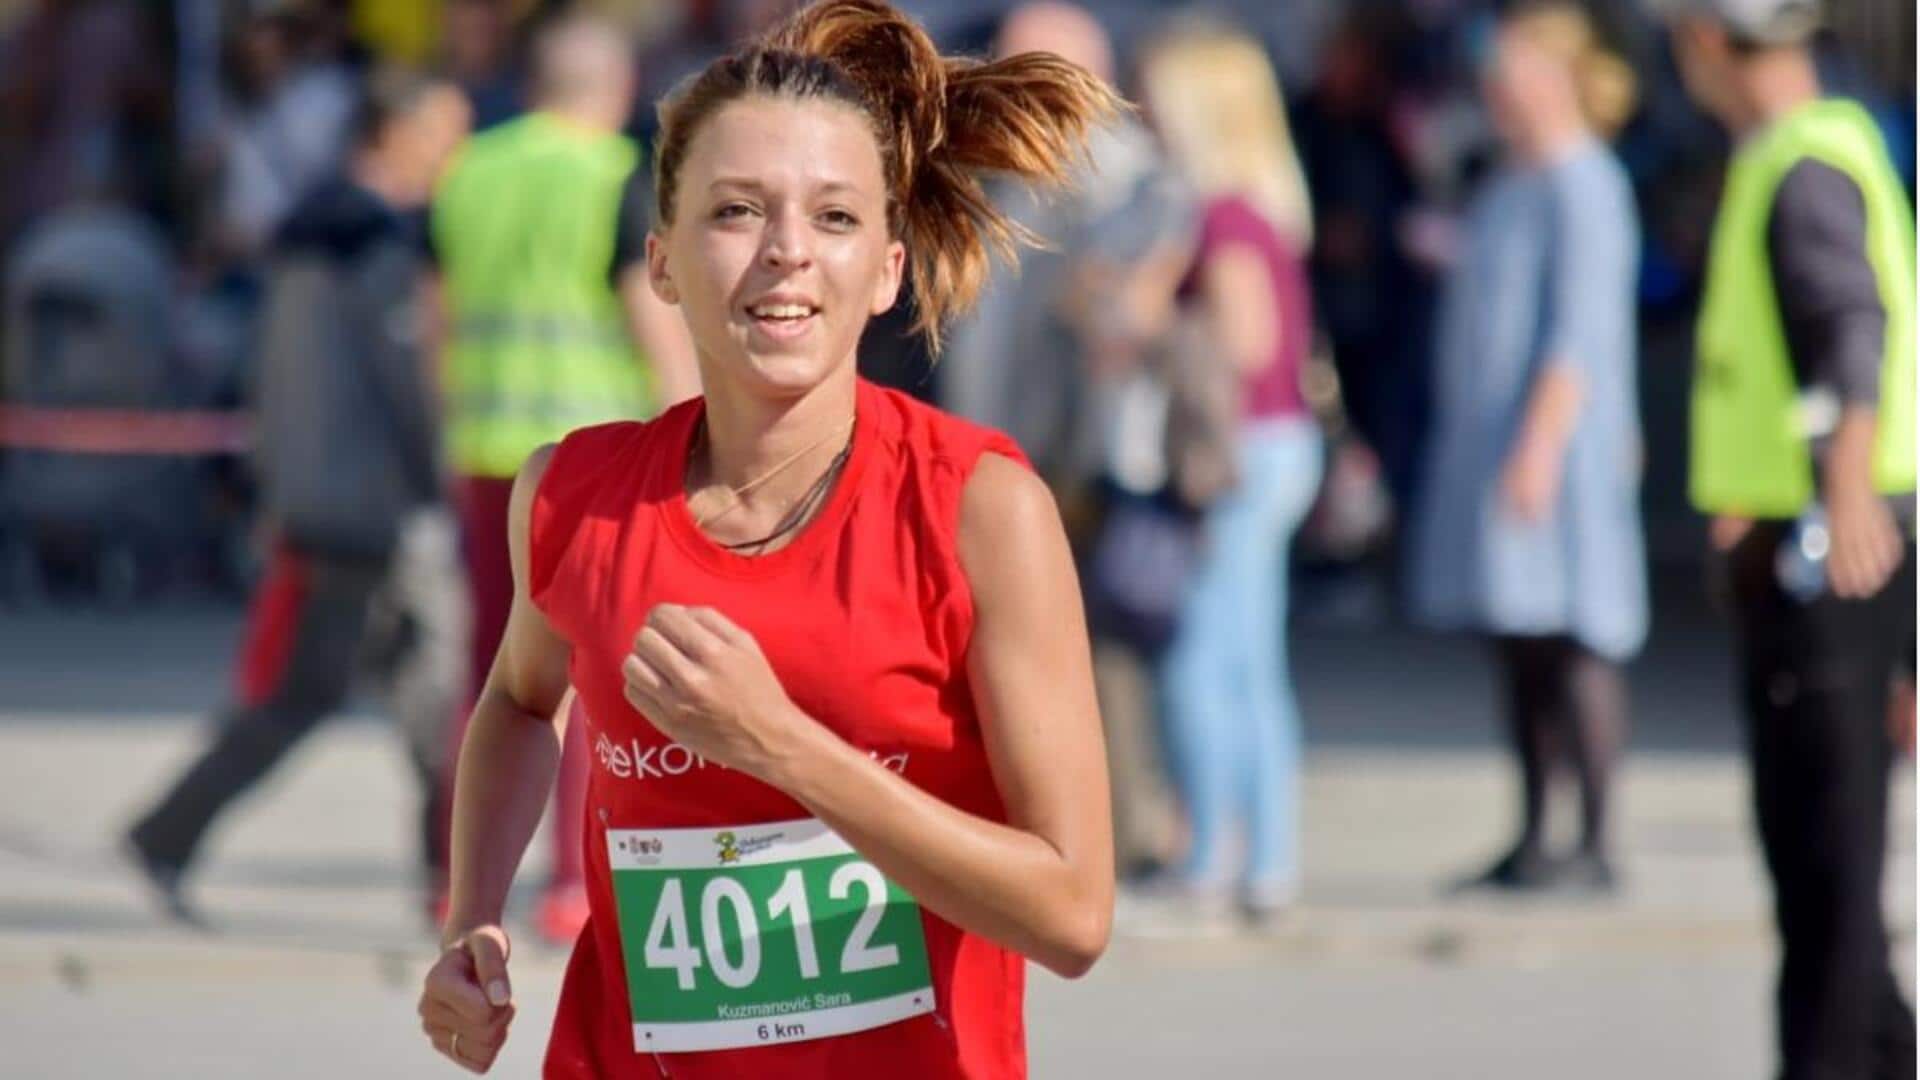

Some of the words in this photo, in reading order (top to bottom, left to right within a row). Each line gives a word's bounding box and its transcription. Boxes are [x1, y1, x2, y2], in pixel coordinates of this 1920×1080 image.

[645, 862, 899, 990] 4012
[718, 998, 811, 1019] Kuzmanović
[814, 991, 851, 1009] Sara
[757, 1025, 769, 1040] 6
[775, 1022, 805, 1037] km
